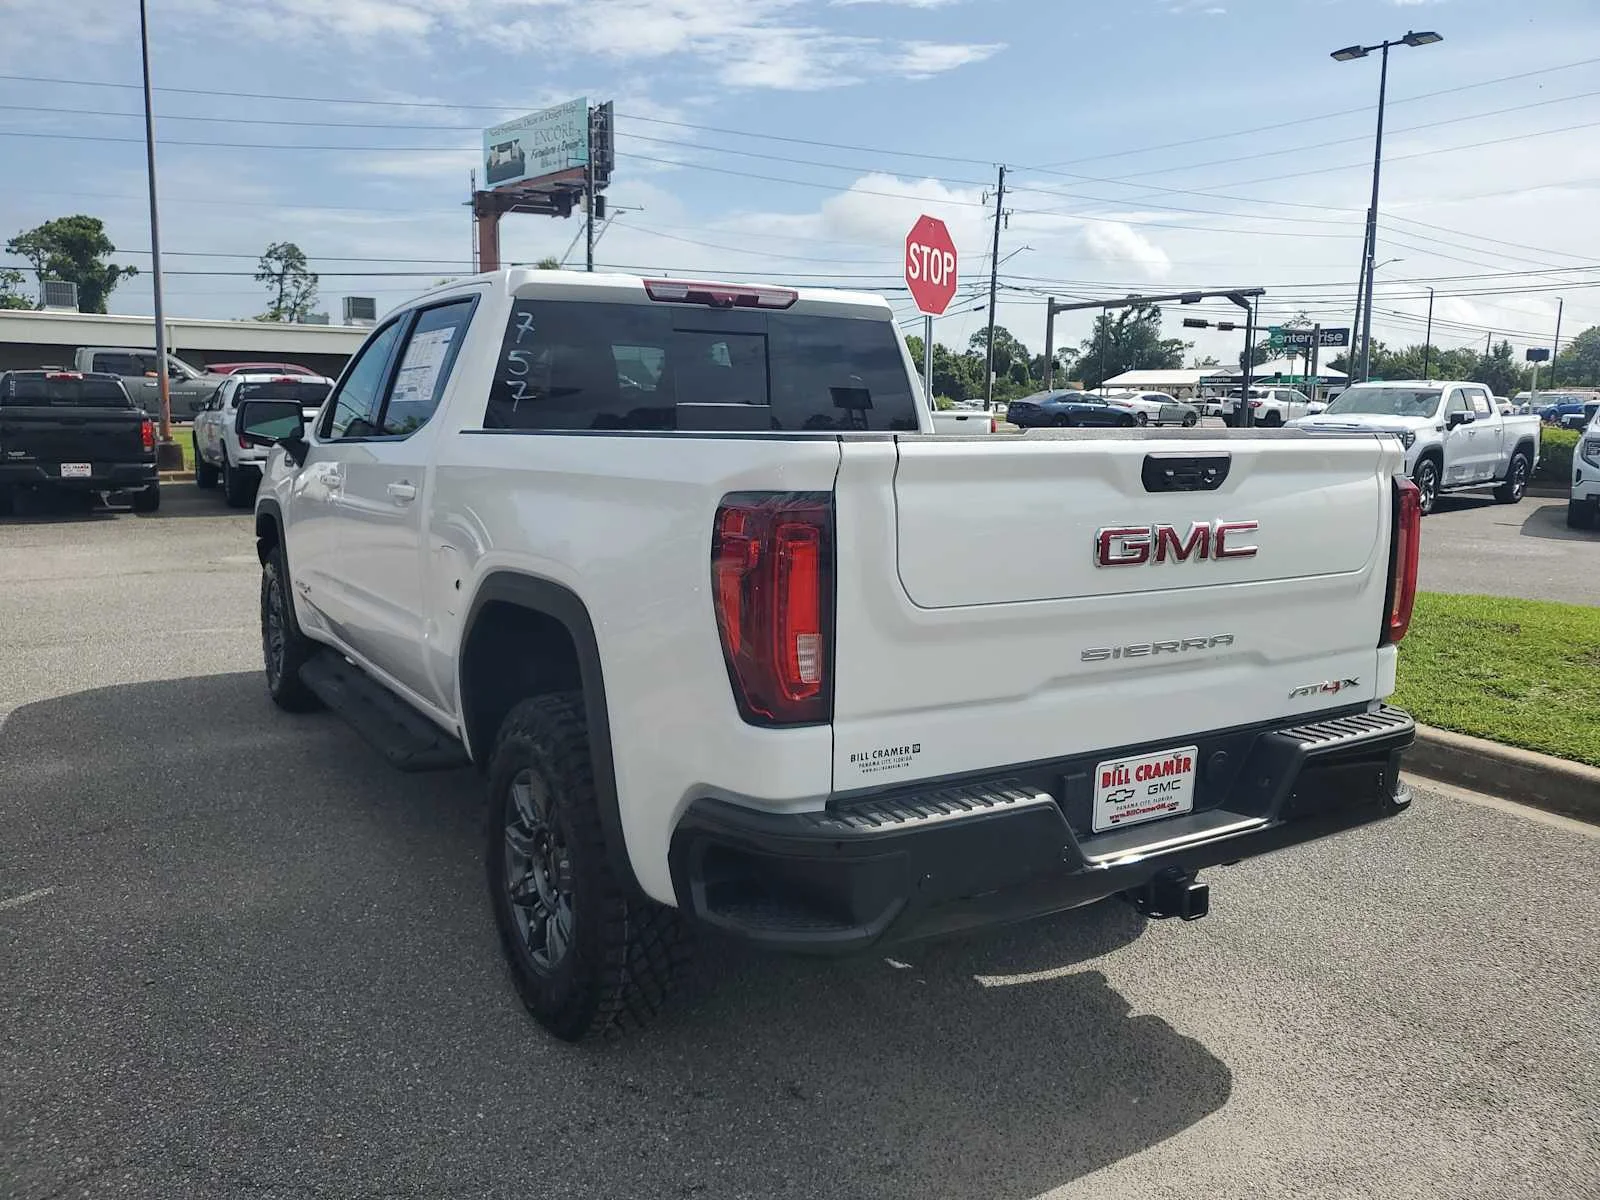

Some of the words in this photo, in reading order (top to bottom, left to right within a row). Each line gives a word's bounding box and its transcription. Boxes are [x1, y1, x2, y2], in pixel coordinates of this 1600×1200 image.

[534, 121, 575, 146] ENCORE
[908, 242, 955, 287] STOP
[1093, 519, 1259, 568] GMC
[1081, 633, 1235, 662] SIERRA
[1288, 676, 1360, 699] AT4X
[850, 752, 869, 763] BILL
[872, 746, 910, 759] CRAMER
[1101, 768, 1131, 789] BILL
[1135, 757, 1192, 782] CRAMER
[1147, 780, 1181, 795] GMC
[1116, 802, 1139, 811] PANAMA
